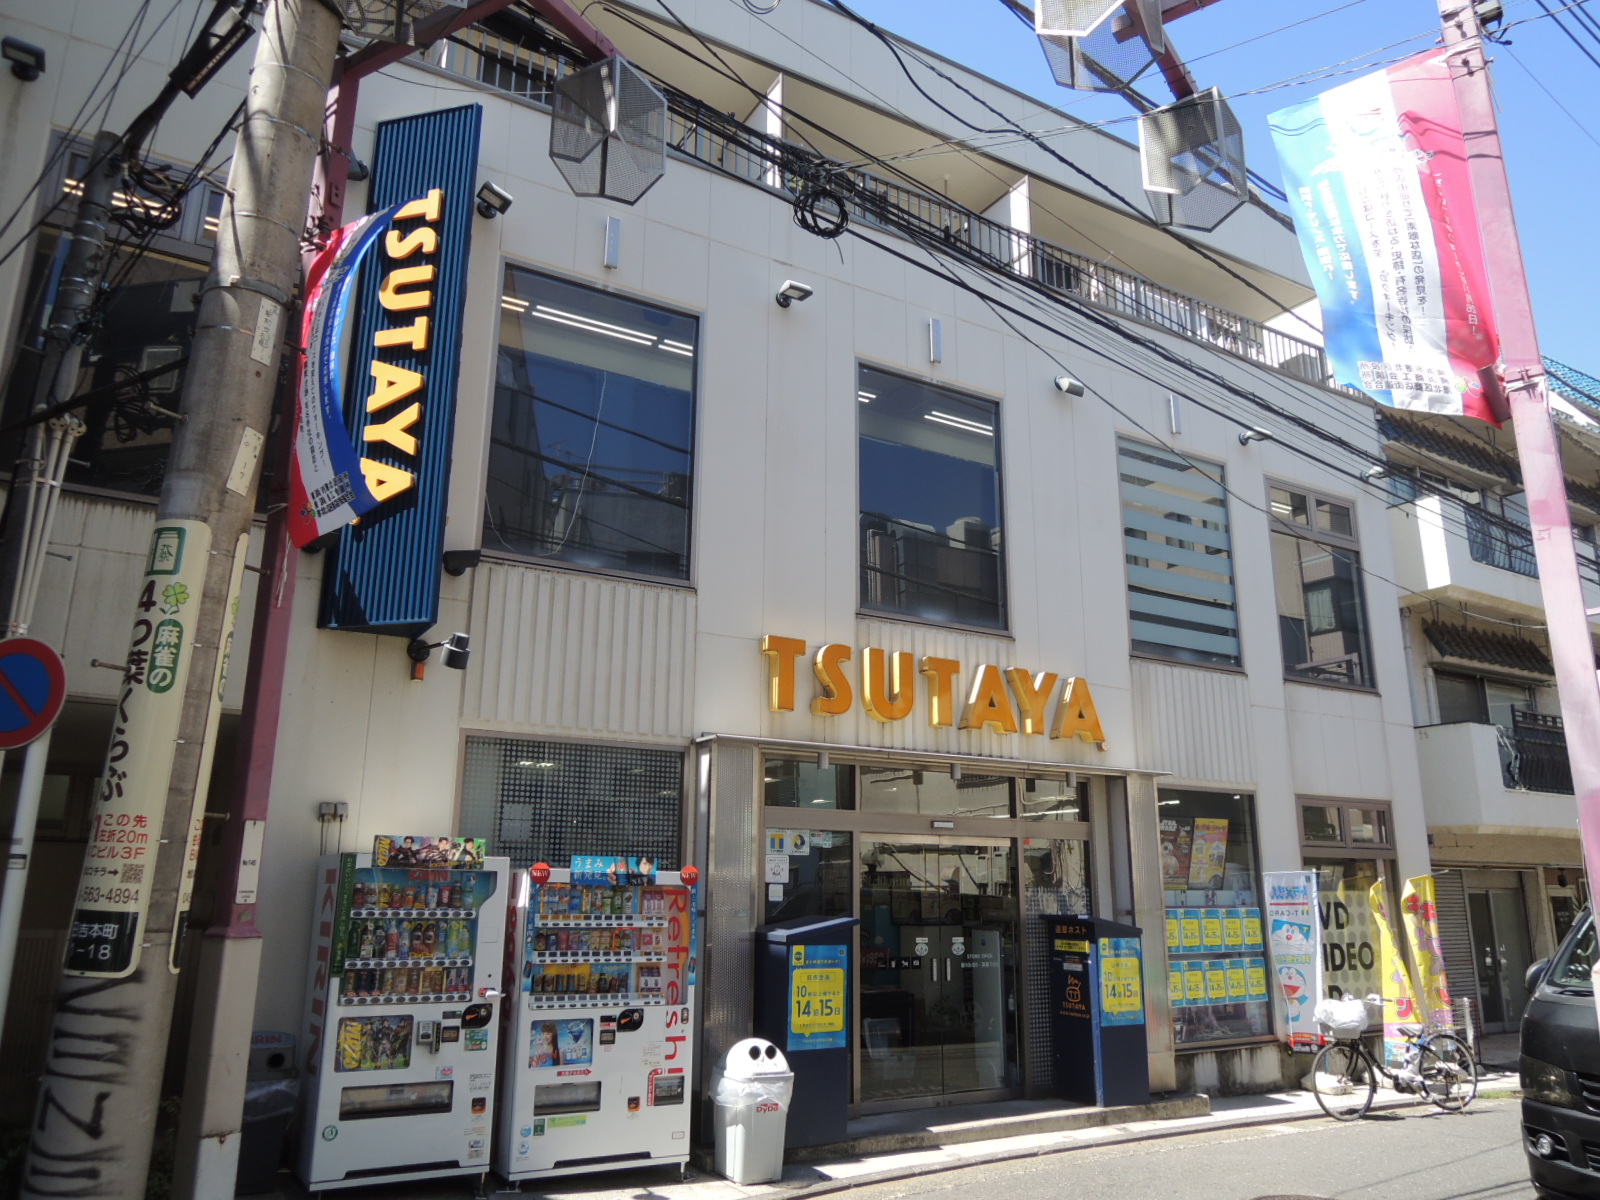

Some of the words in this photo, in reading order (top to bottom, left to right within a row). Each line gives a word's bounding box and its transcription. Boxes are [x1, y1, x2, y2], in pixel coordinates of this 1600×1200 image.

[361, 187, 442, 502] TSUTAYA
[149, 625, 181, 687] 麻雀の
[761, 634, 1107, 744] TSUTAYA
[103, 813, 148, 828] この先
[99, 829, 149, 844] 左折20m
[573, 857, 605, 869] うまみ
[530, 869, 549, 877] NEW
[680, 871, 698, 879] NEW
[795, 998, 842, 1019] 14泊15日
[252, 1034, 282, 1044] RIN
[755, 1102, 780, 1114] DyDo
